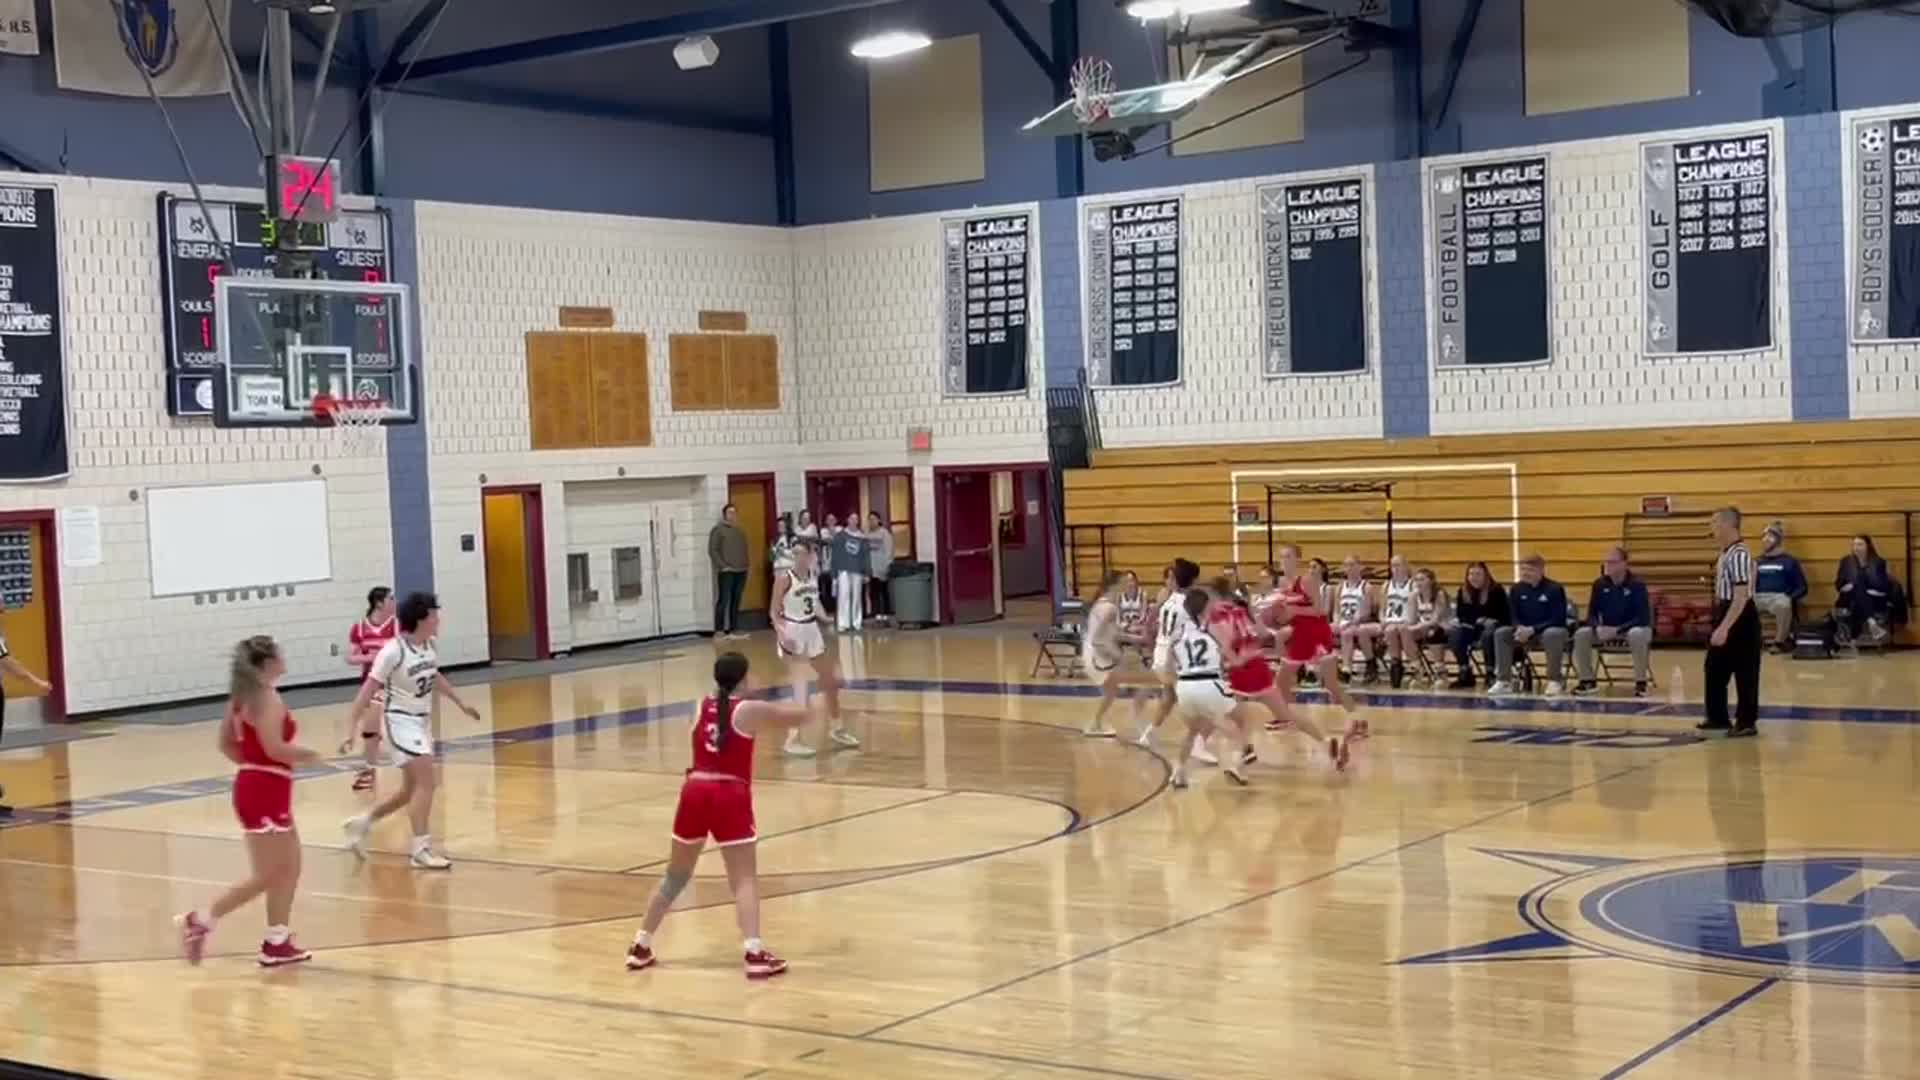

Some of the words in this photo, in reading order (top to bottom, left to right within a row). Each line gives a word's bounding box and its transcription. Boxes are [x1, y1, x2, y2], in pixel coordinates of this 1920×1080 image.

[1676, 138, 1767, 163] LEAGUE
[1463, 165, 1544, 188] LEAGUE
[1678, 159, 1766, 182] CHAMPIONS
[282, 161, 334, 216] 24
[1288, 185, 1361, 206] LEAGUE
[1465, 187, 1542, 208] CHAMPIONS
[1863, 158, 1884, 240] SOCCER
[1112, 202, 1178, 223] LEAGUE
[1290, 205, 1359, 225] CHAMPIONS
[967, 217, 1027, 238] LEAGUE
[1113, 220, 1177, 242] CHAMPIONS
[967, 235, 1026, 254] CHAMPIONS
[1266, 219, 1283, 290] HOCKEY
[1651, 209, 1671, 290] GOLF
[336, 250, 385, 267] GUEST
[1440, 203, 1459, 324] FOOTBALL
[1862, 248, 1882, 303] BOYS
[1269, 296, 1286, 348] FIELD
[803, 595, 814, 615] 3
[1185, 638, 1209, 668] 12
